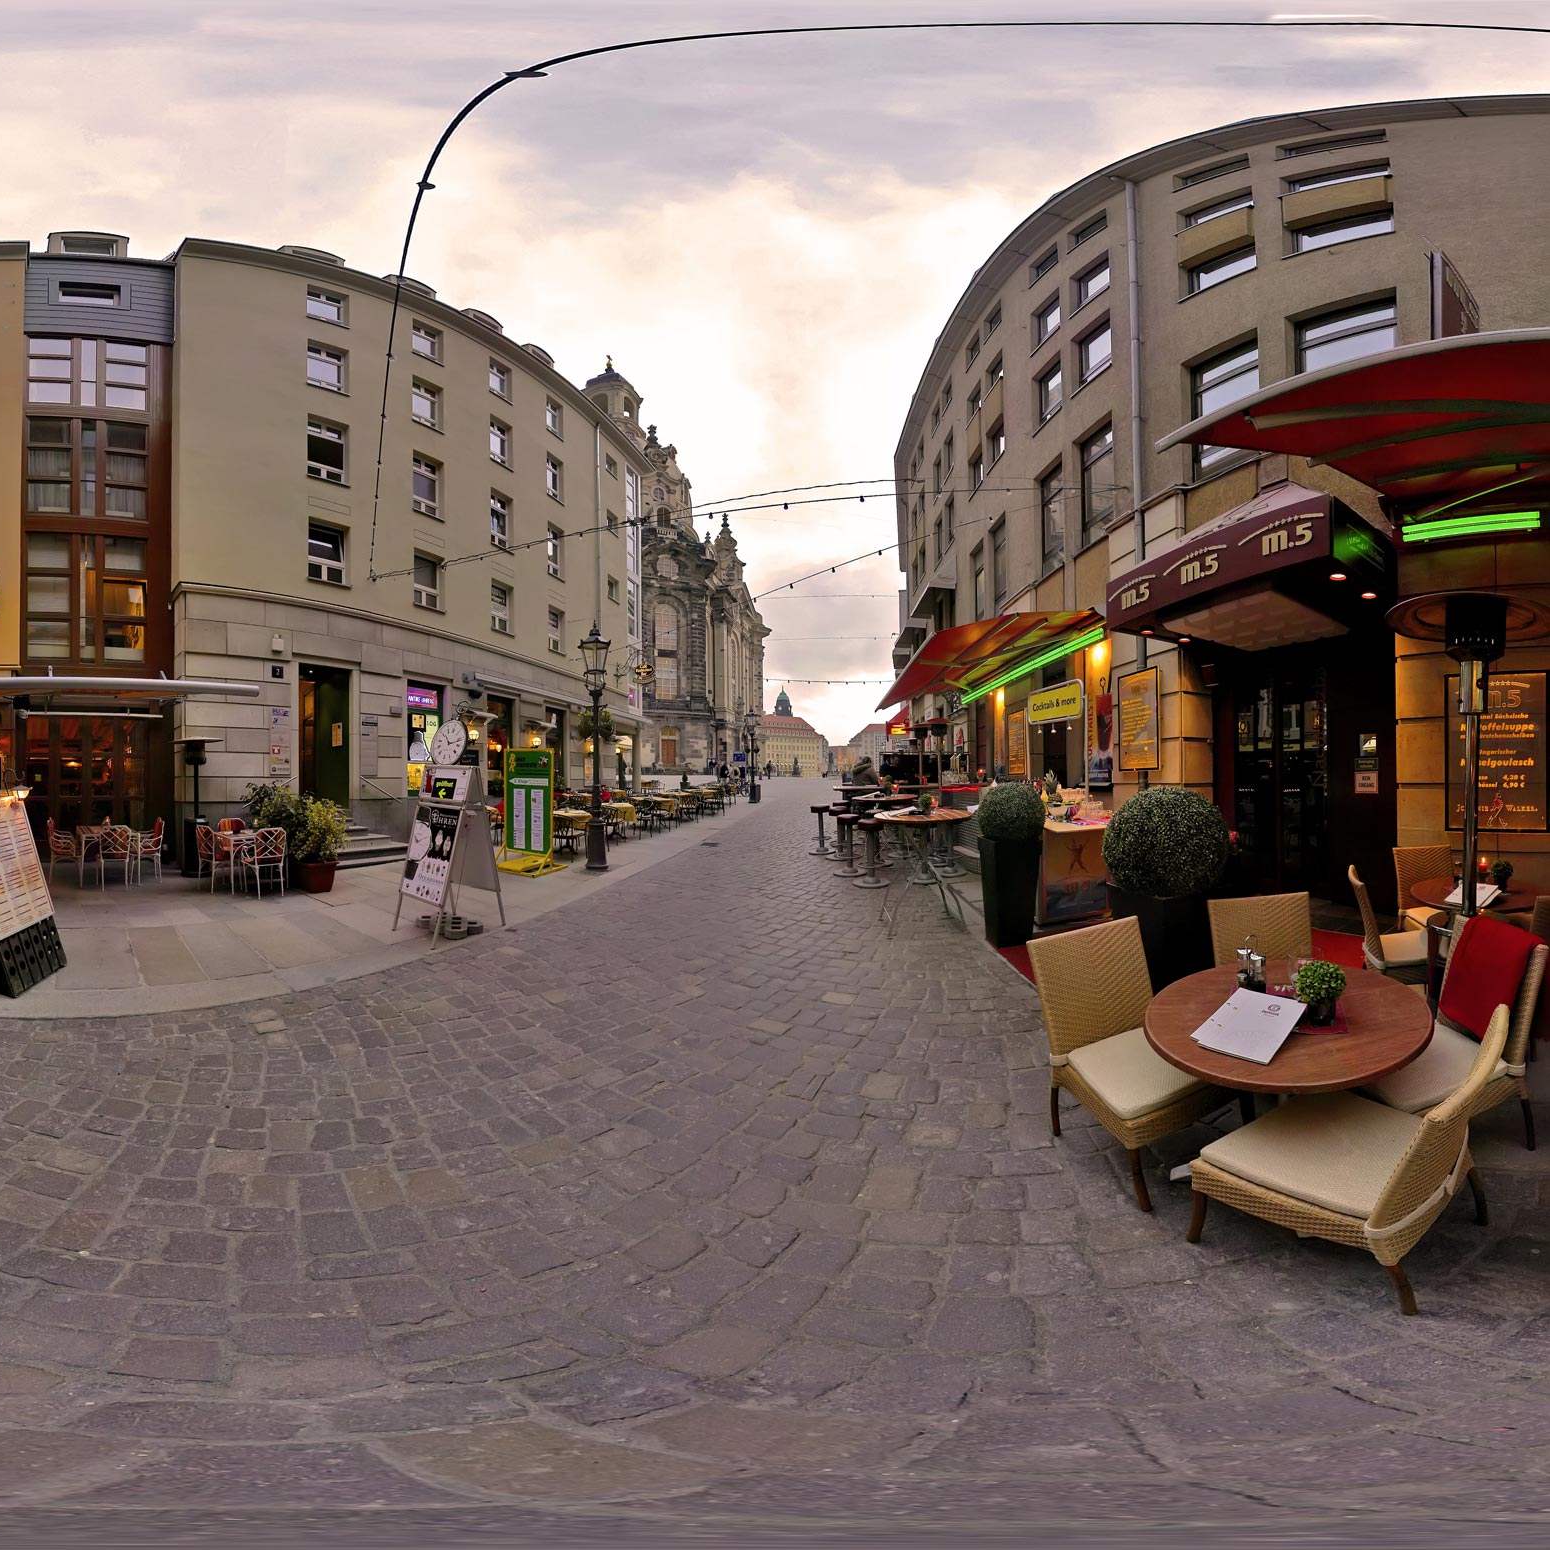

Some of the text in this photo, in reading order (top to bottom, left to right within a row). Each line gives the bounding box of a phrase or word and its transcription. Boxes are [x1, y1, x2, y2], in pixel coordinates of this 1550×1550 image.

[1262, 521, 1313, 556] m.5
[1180, 552, 1219, 585] m.5
[1121, 581, 1150, 611] m.5
[1032, 697, 1077, 712] Cocktails & more
[1460, 722, 1535, 732] Koffelsuppe
[1460, 757, 1535, 769] Kelgoulasch
